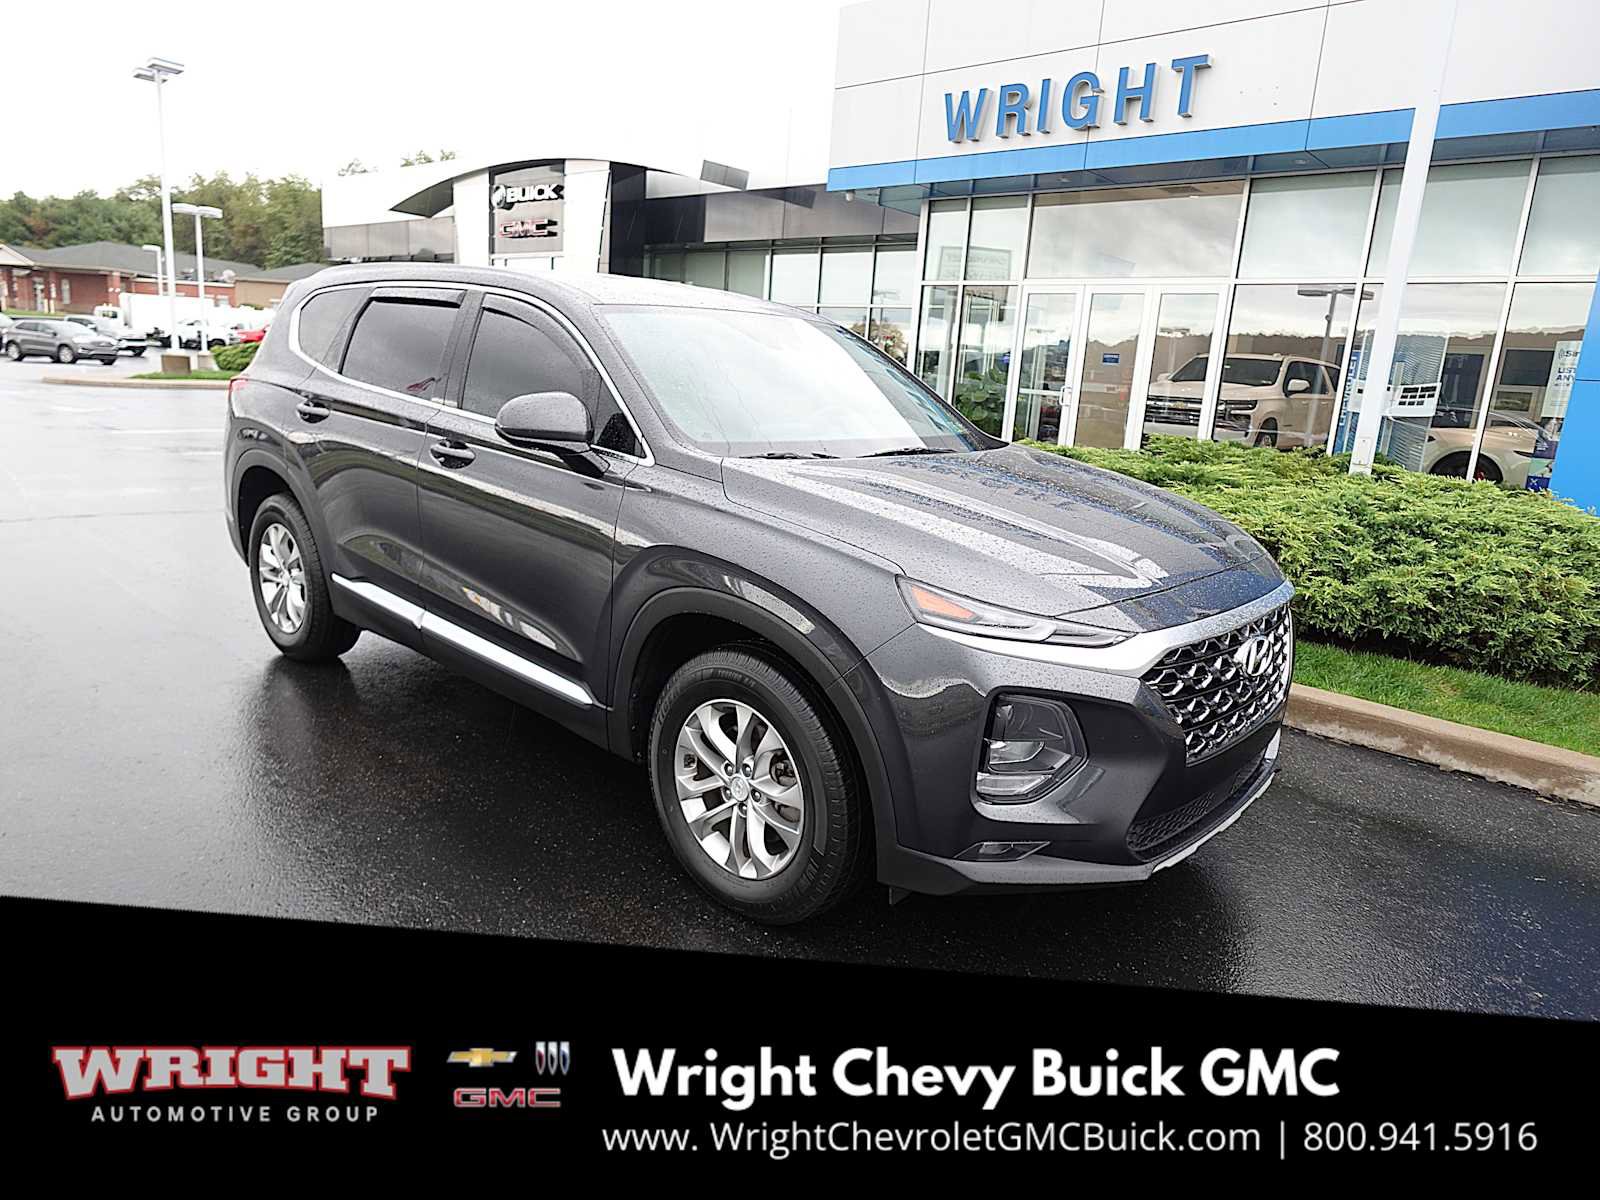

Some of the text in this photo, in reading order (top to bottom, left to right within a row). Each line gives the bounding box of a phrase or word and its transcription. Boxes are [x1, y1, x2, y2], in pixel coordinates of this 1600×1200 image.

[944, 54, 1212, 143] WRIGHT
[506, 184, 558, 203] BUICK
[499, 218, 551, 238] GMC
